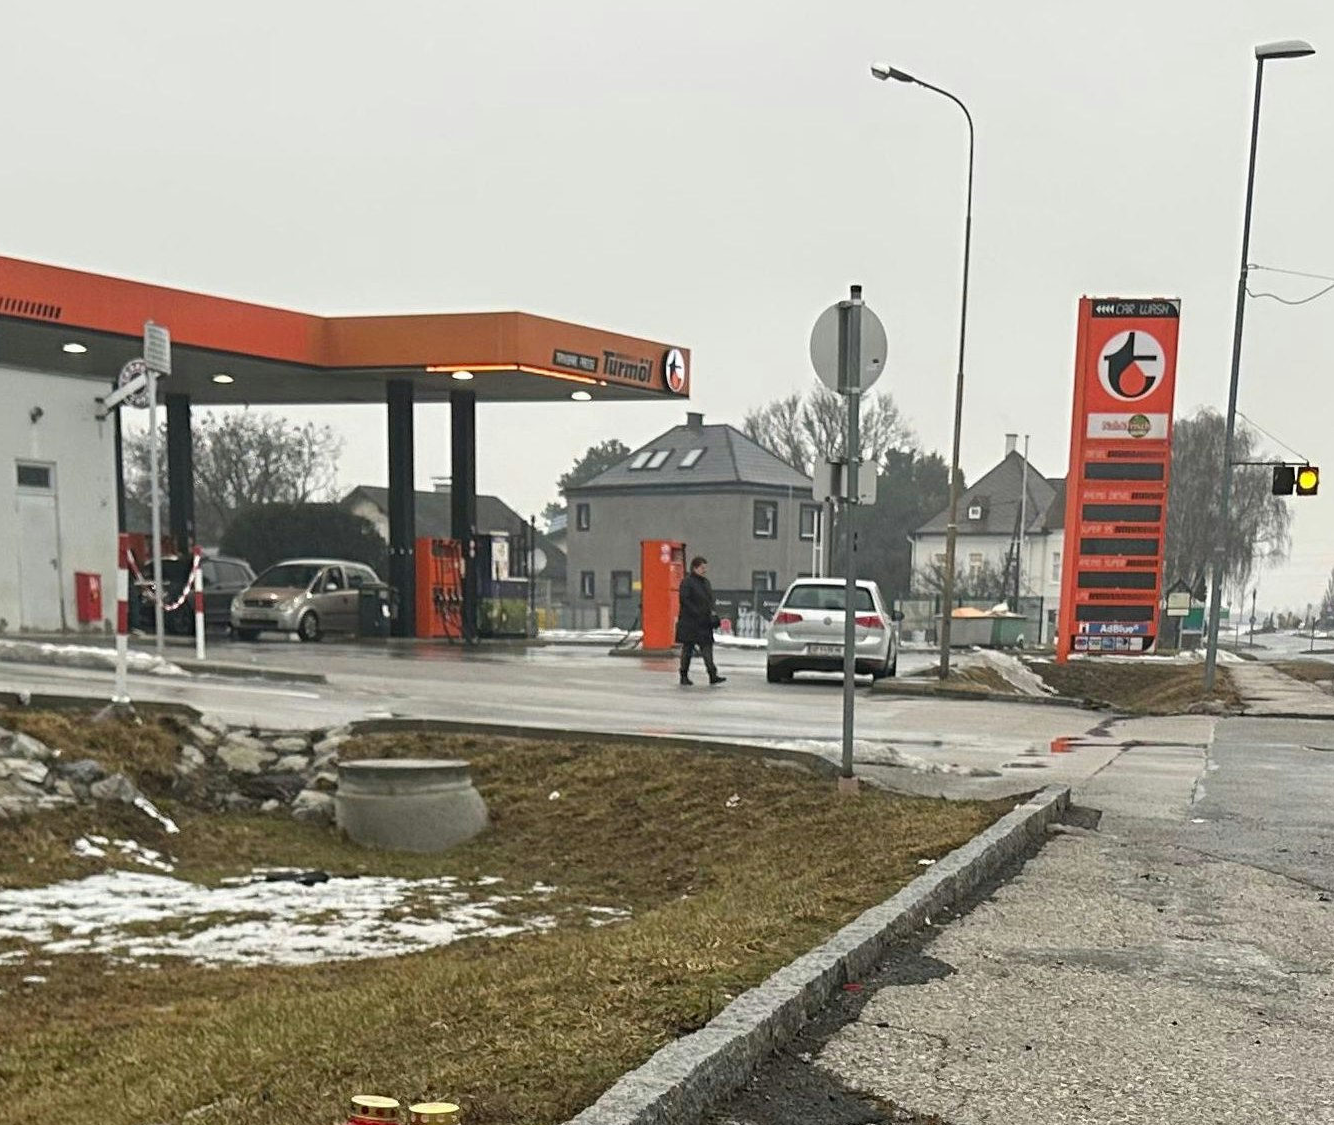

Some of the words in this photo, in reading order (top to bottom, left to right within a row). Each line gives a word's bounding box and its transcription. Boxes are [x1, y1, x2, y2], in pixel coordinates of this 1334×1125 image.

[1115, 303, 1135, 315] CAR
[1139, 303, 1170, 315] WASH
[602, 350, 654, 383] Turmöl
